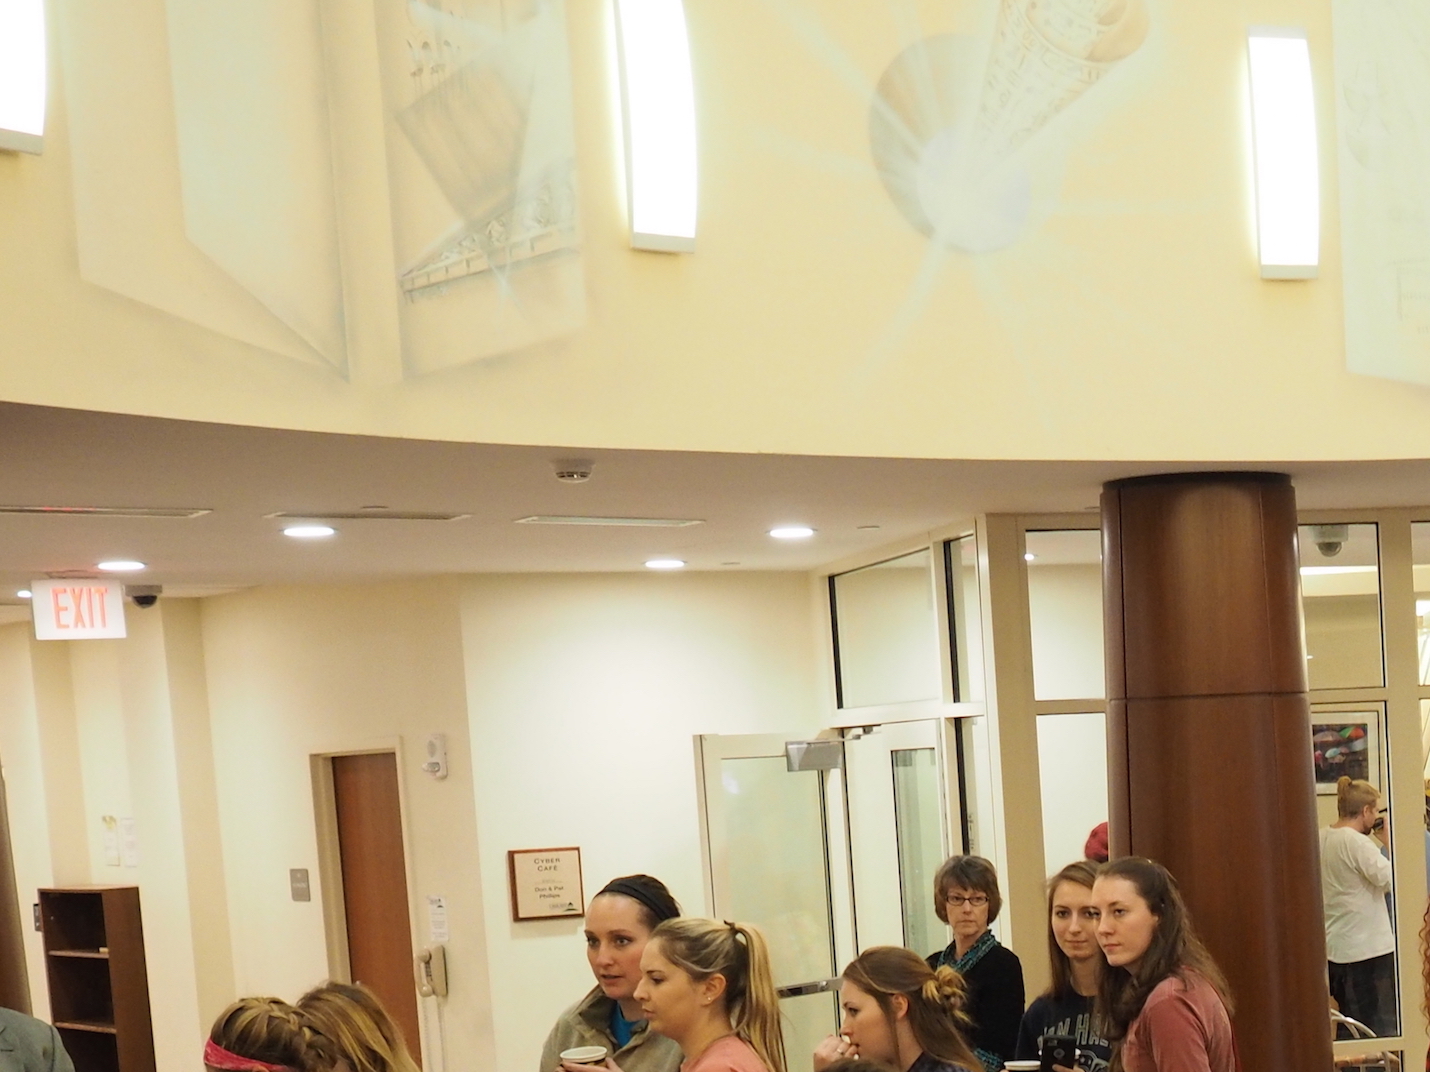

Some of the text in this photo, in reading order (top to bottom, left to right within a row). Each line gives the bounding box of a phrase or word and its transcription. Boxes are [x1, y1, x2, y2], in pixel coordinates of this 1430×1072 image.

[50, 586, 108, 629] EXIT
[533, 857, 561, 865] CYBER
[537, 864, 558, 872] CAFÉ
